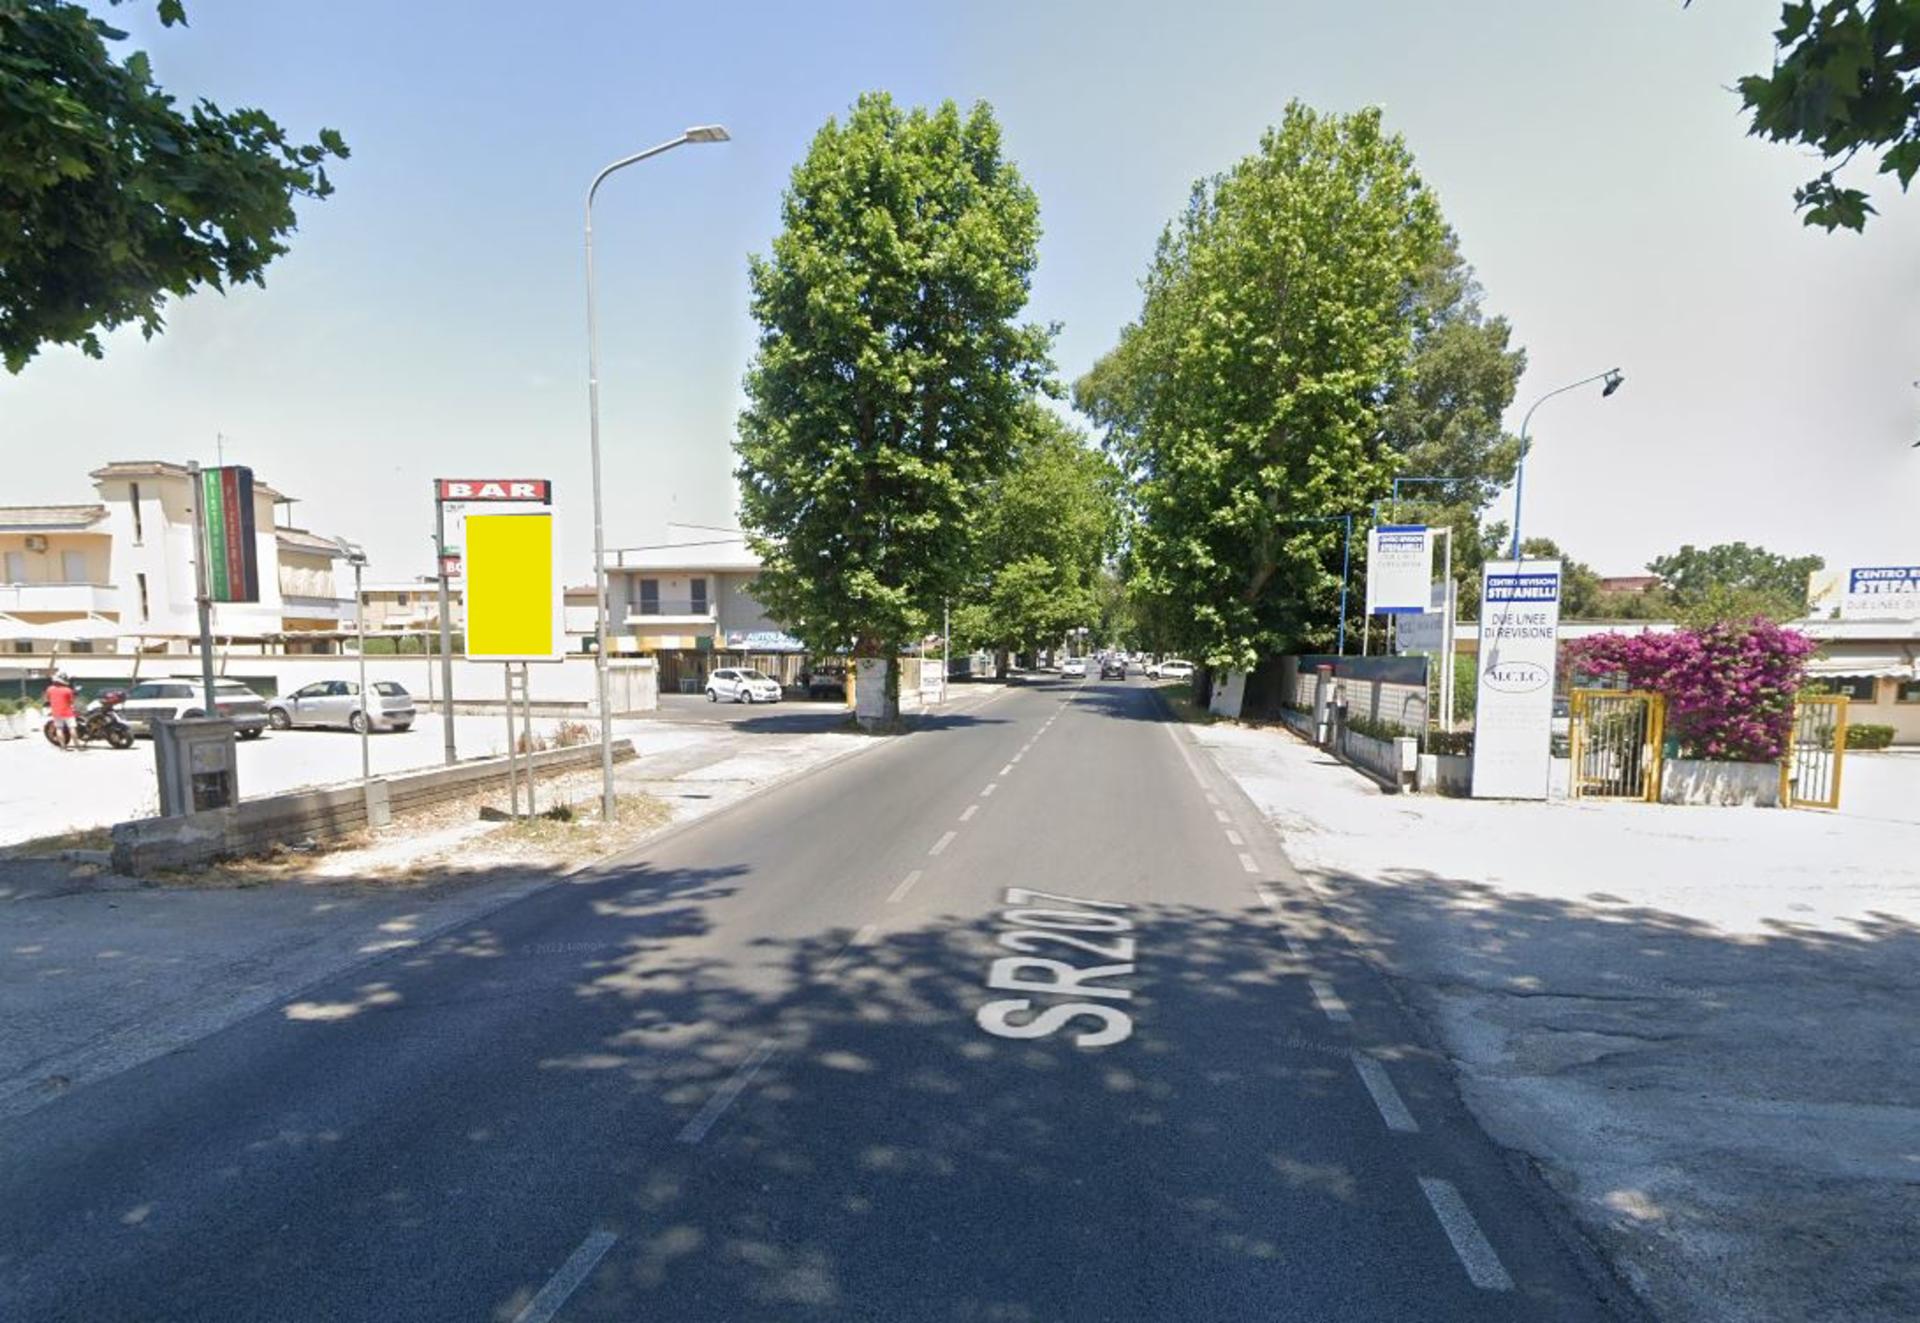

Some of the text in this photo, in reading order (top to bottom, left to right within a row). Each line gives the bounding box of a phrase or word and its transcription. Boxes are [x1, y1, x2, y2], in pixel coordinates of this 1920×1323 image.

[448, 482, 536, 497] BAR
[1854, 570, 1906, 579] CENTRO
[1519, 578, 1556, 586] REVISIONI
[1488, 587, 1556, 599] STEFANELLI
[1492, 613, 1546, 625] DUE LINEE
[1485, 627, 1554, 638] DI REVISIONE
[976, 887, 1135, 1047] SR207
